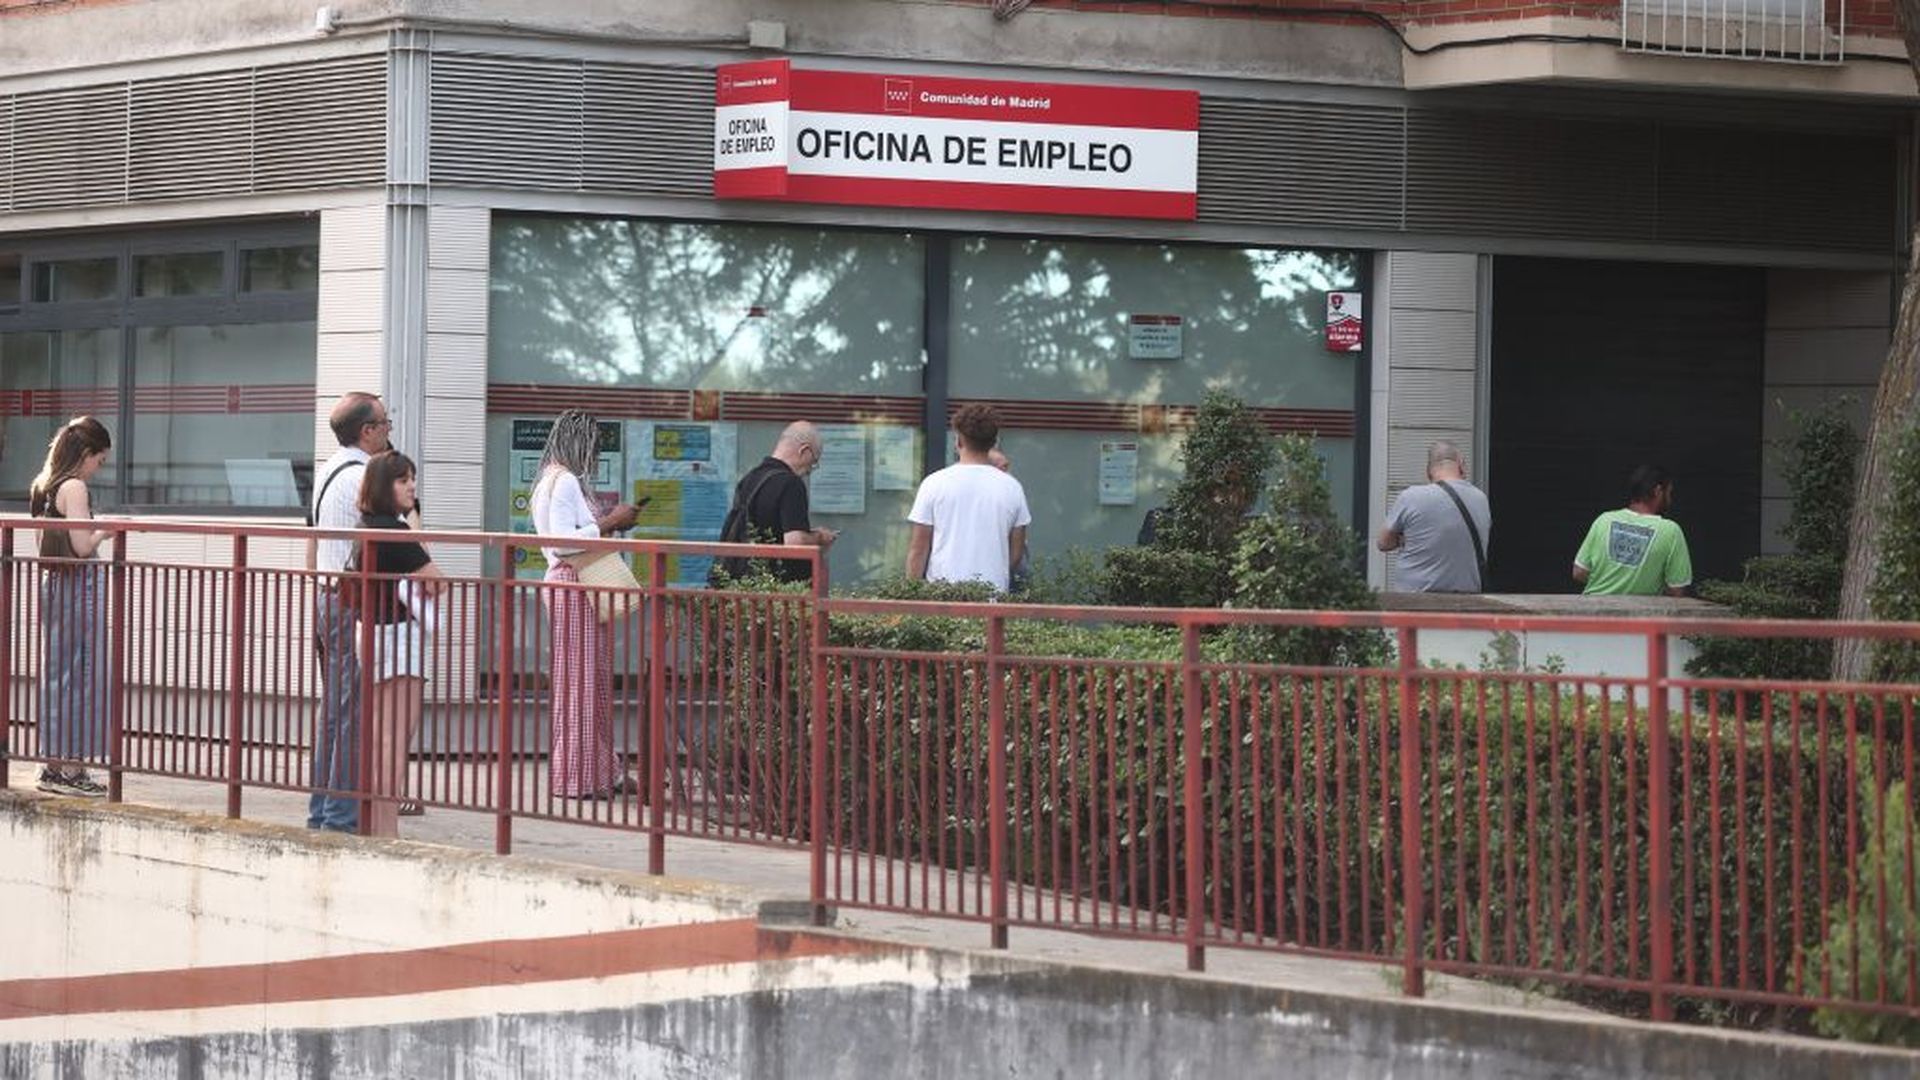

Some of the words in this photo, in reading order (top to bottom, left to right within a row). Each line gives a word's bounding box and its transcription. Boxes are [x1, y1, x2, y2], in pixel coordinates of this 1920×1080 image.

[920, 91, 987, 106] Comunidad
[991, 96, 1006, 106] de
[1009, 96, 1050, 109] Madrid
[728, 117, 767, 135] OFICINA
[721, 139, 733, 155] DE
[735, 136, 775, 154] EMPLEO
[796, 127, 932, 164] OFICINA
[944, 135, 986, 165] DE
[998, 138, 1133, 173] EMPLEO
